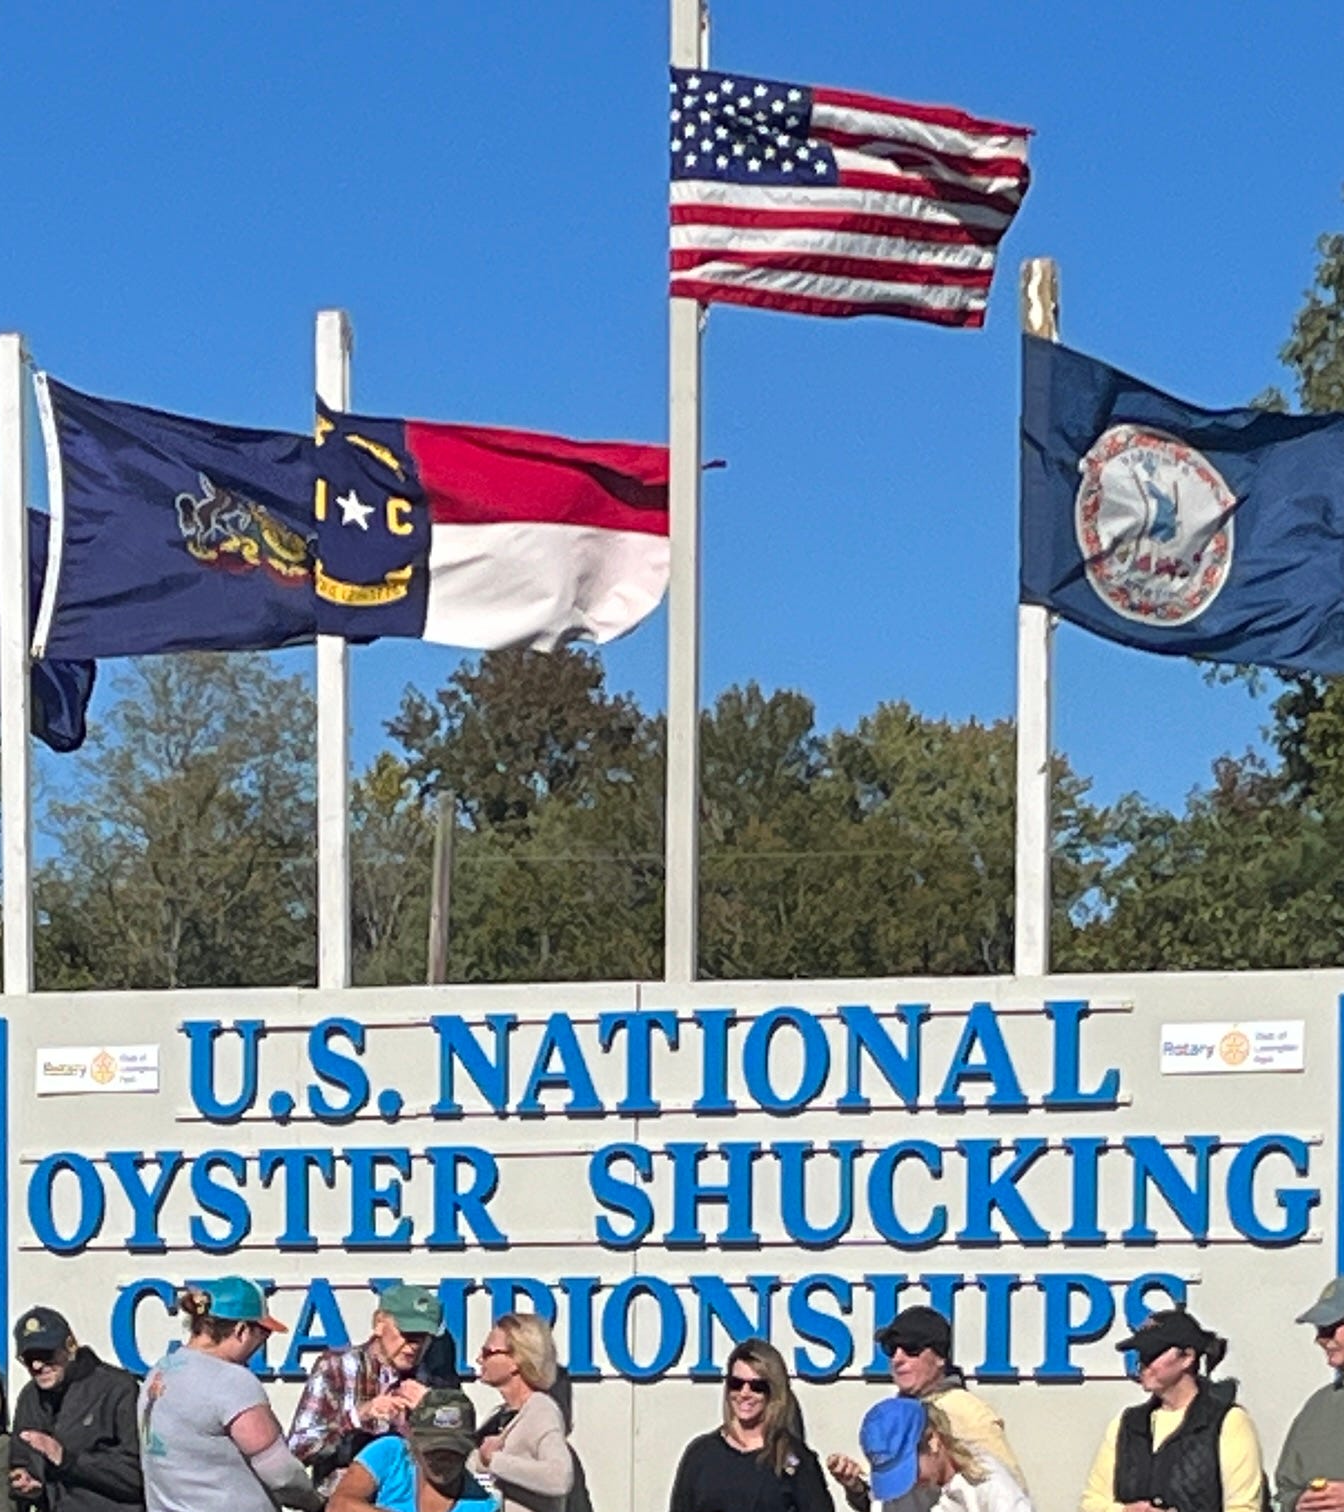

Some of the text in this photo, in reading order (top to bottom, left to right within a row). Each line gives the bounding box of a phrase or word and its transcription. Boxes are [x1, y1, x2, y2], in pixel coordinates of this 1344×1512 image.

[1163, 1040, 1215, 1060] Rotary
[27, 1134, 1321, 1257] OYSTER SHUCKING
